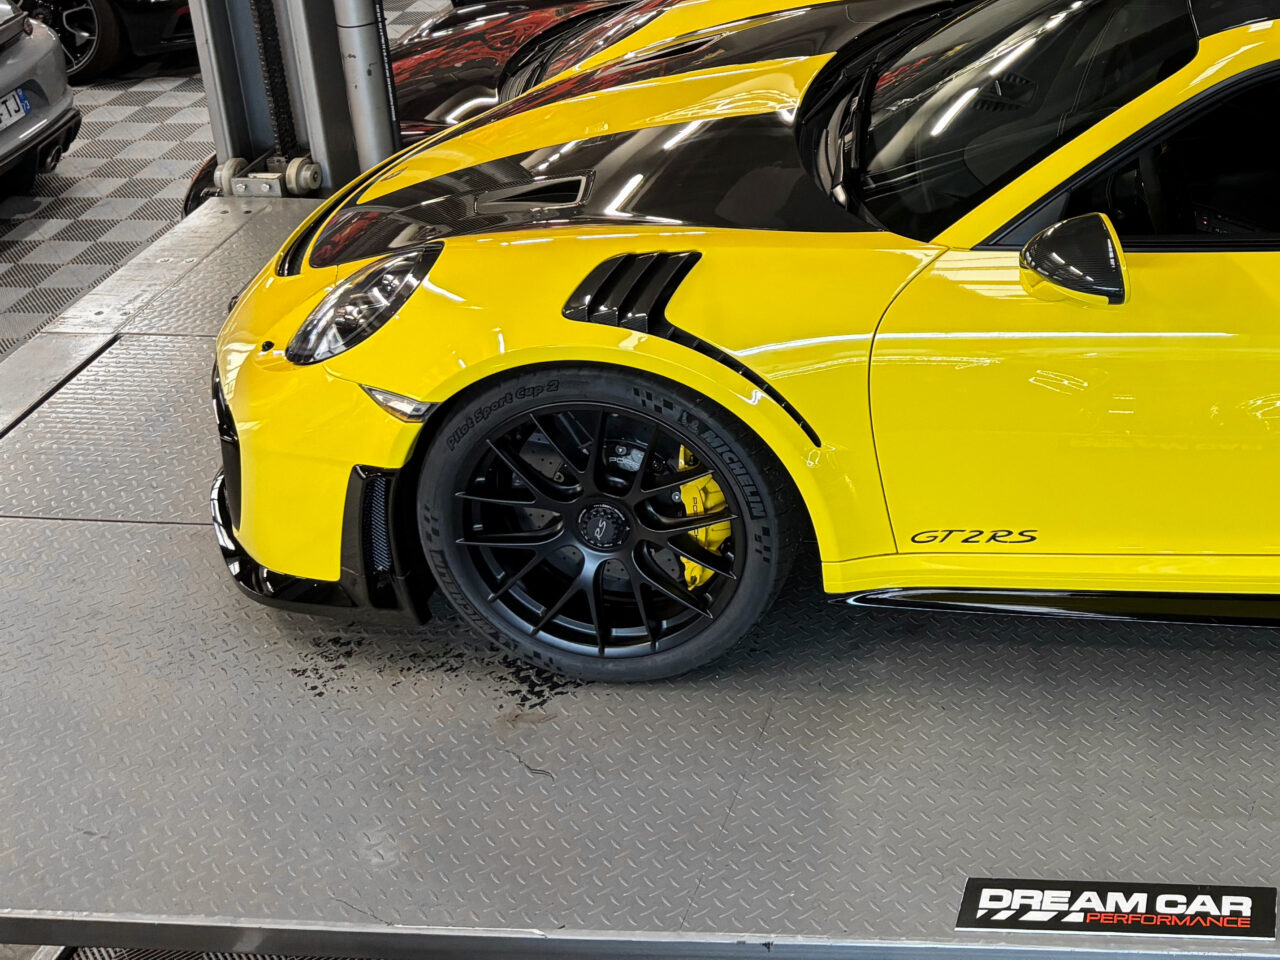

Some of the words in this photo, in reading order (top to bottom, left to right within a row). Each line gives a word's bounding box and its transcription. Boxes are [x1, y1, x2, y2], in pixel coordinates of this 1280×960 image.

[446, 419, 476, 452] Pilot
[474, 392, 514, 424] Sport
[515, 383, 546, 401] Cup
[545, 379, 560, 393] 2
[702, 429, 767, 520] MICHELIN
[978, 888, 1148, 914] DREAM
[1155, 893, 1253, 917] CAR
[1085, 912, 1251, 929] PERFORMANCE
